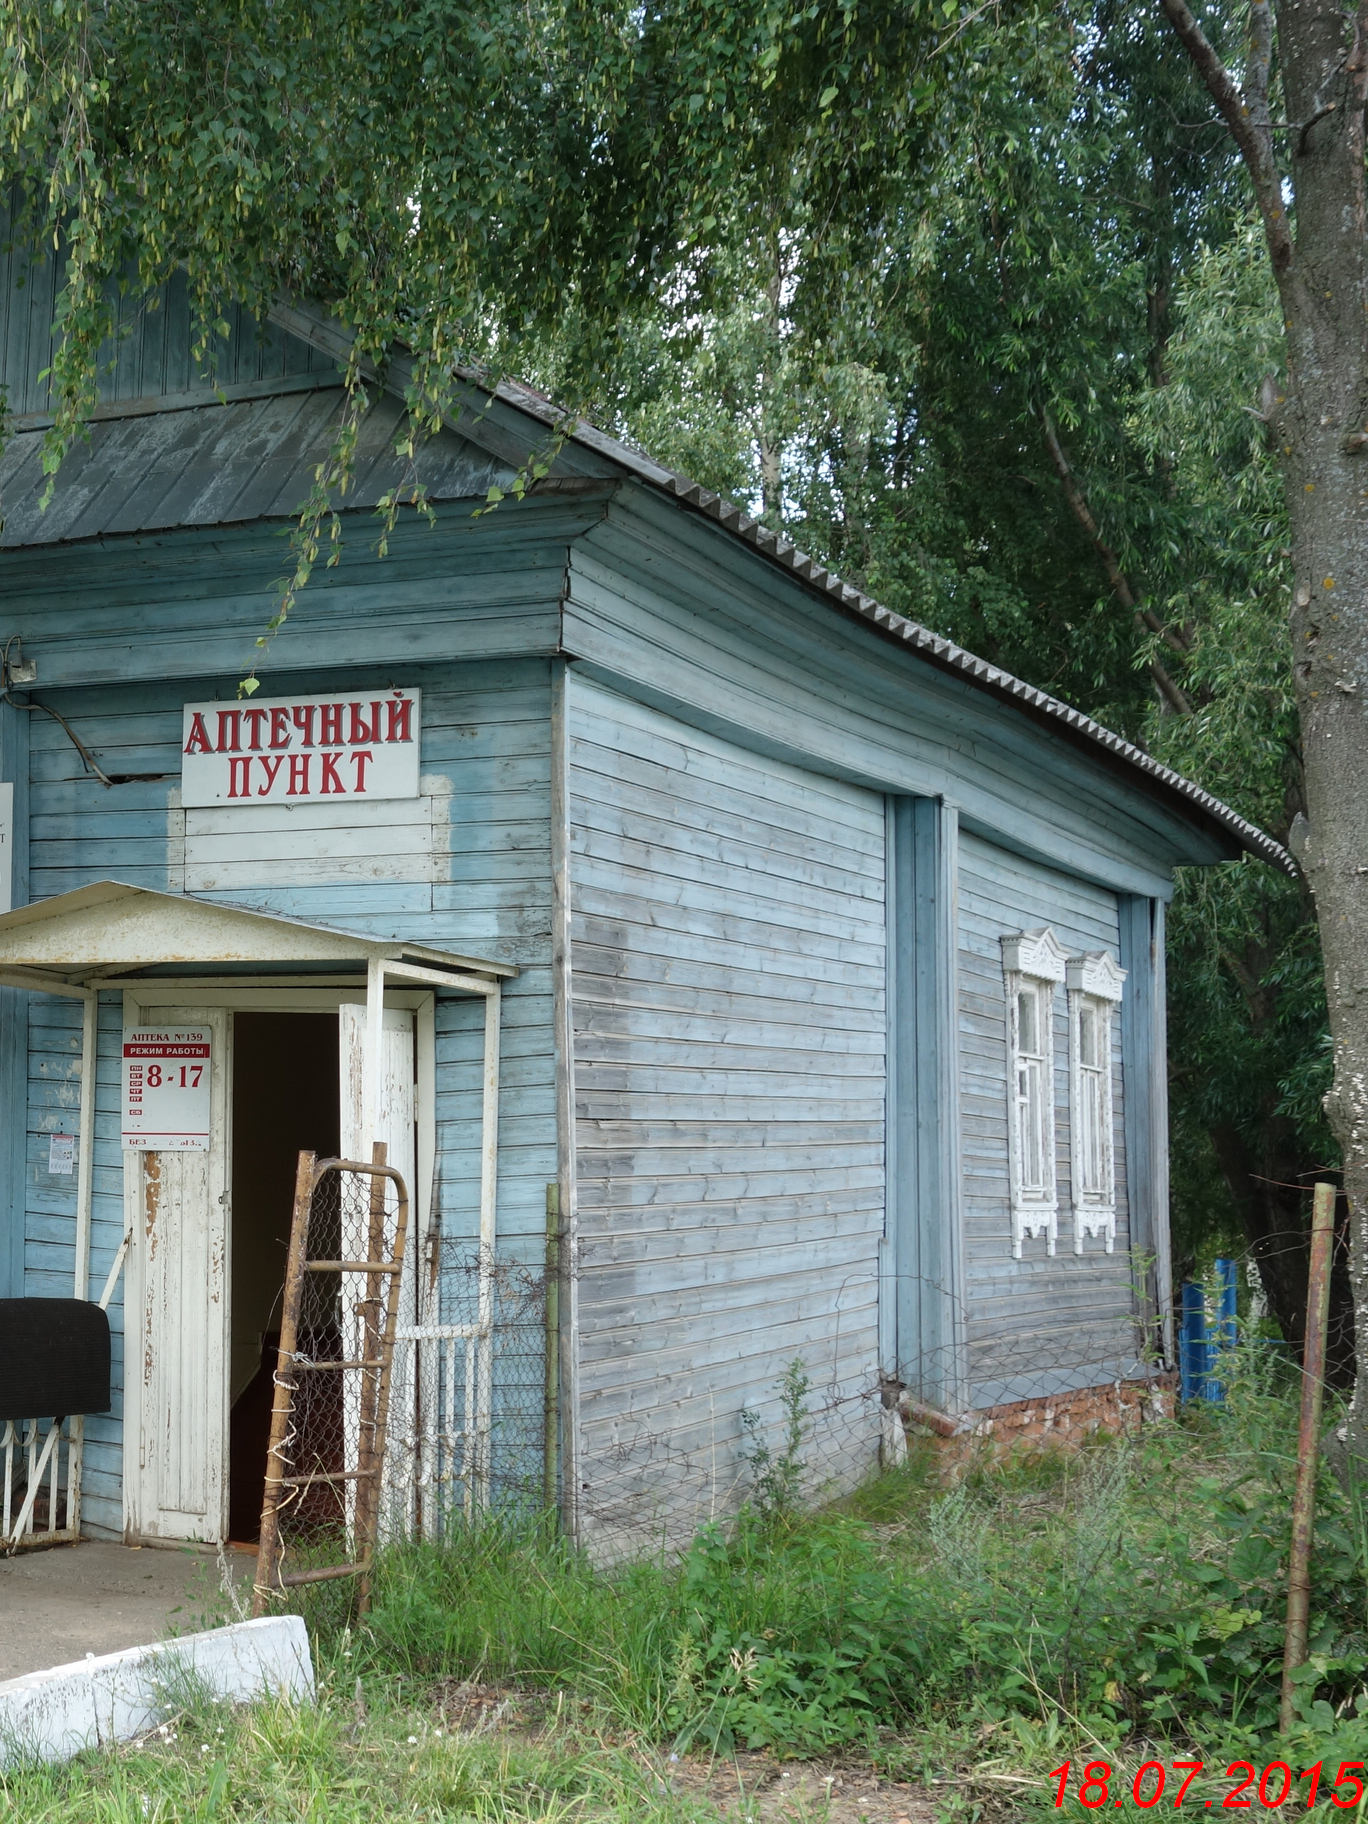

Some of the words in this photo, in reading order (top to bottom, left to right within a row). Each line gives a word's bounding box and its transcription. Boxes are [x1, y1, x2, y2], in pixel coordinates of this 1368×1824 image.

[183, 691, 414, 754] АПТЕЧНЫЙ
[227, 750, 374, 798] ПУНКТ
[130, 1047, 163, 1055] РЕЖИМ
[166, 1047, 204, 1055] РАБОТЫ
[131, 1033, 170, 1042] АПТЕКА
